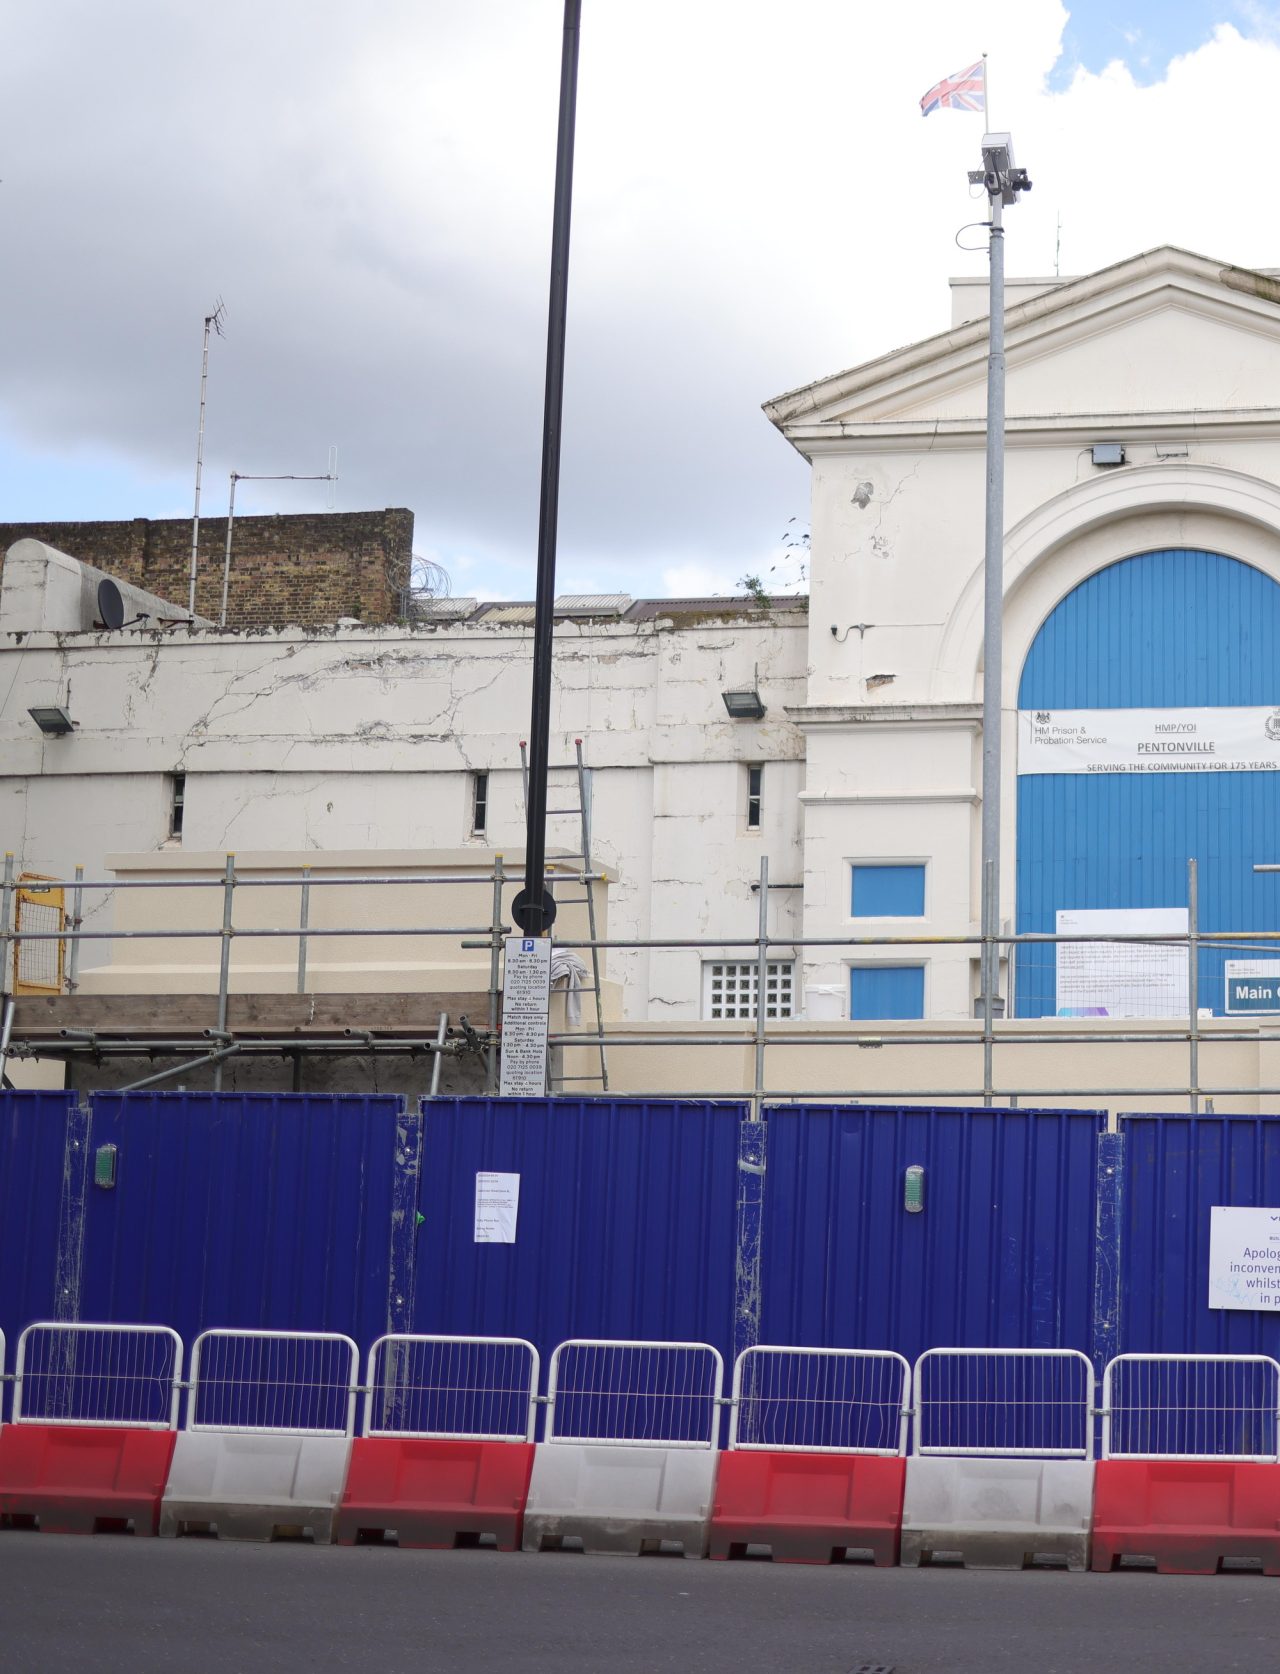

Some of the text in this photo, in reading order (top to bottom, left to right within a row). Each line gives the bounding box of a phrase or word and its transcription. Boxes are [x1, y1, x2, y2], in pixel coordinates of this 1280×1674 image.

[1034, 727, 1086, 735] HM Prison &
[1155, 723, 1197, 733] HMP/YOI
[1034, 736, 1107, 745] Probation Service
[1137, 741, 1215, 753] PENTONVILLE
[1087, 761, 1277, 772] SERVING THE COMMUNITY FOR 175 YEARS
[1235, 985, 1272, 999] Main
[1246, 1277, 1280, 1289] whilst
[1260, 1292, 1271, 1304] in
